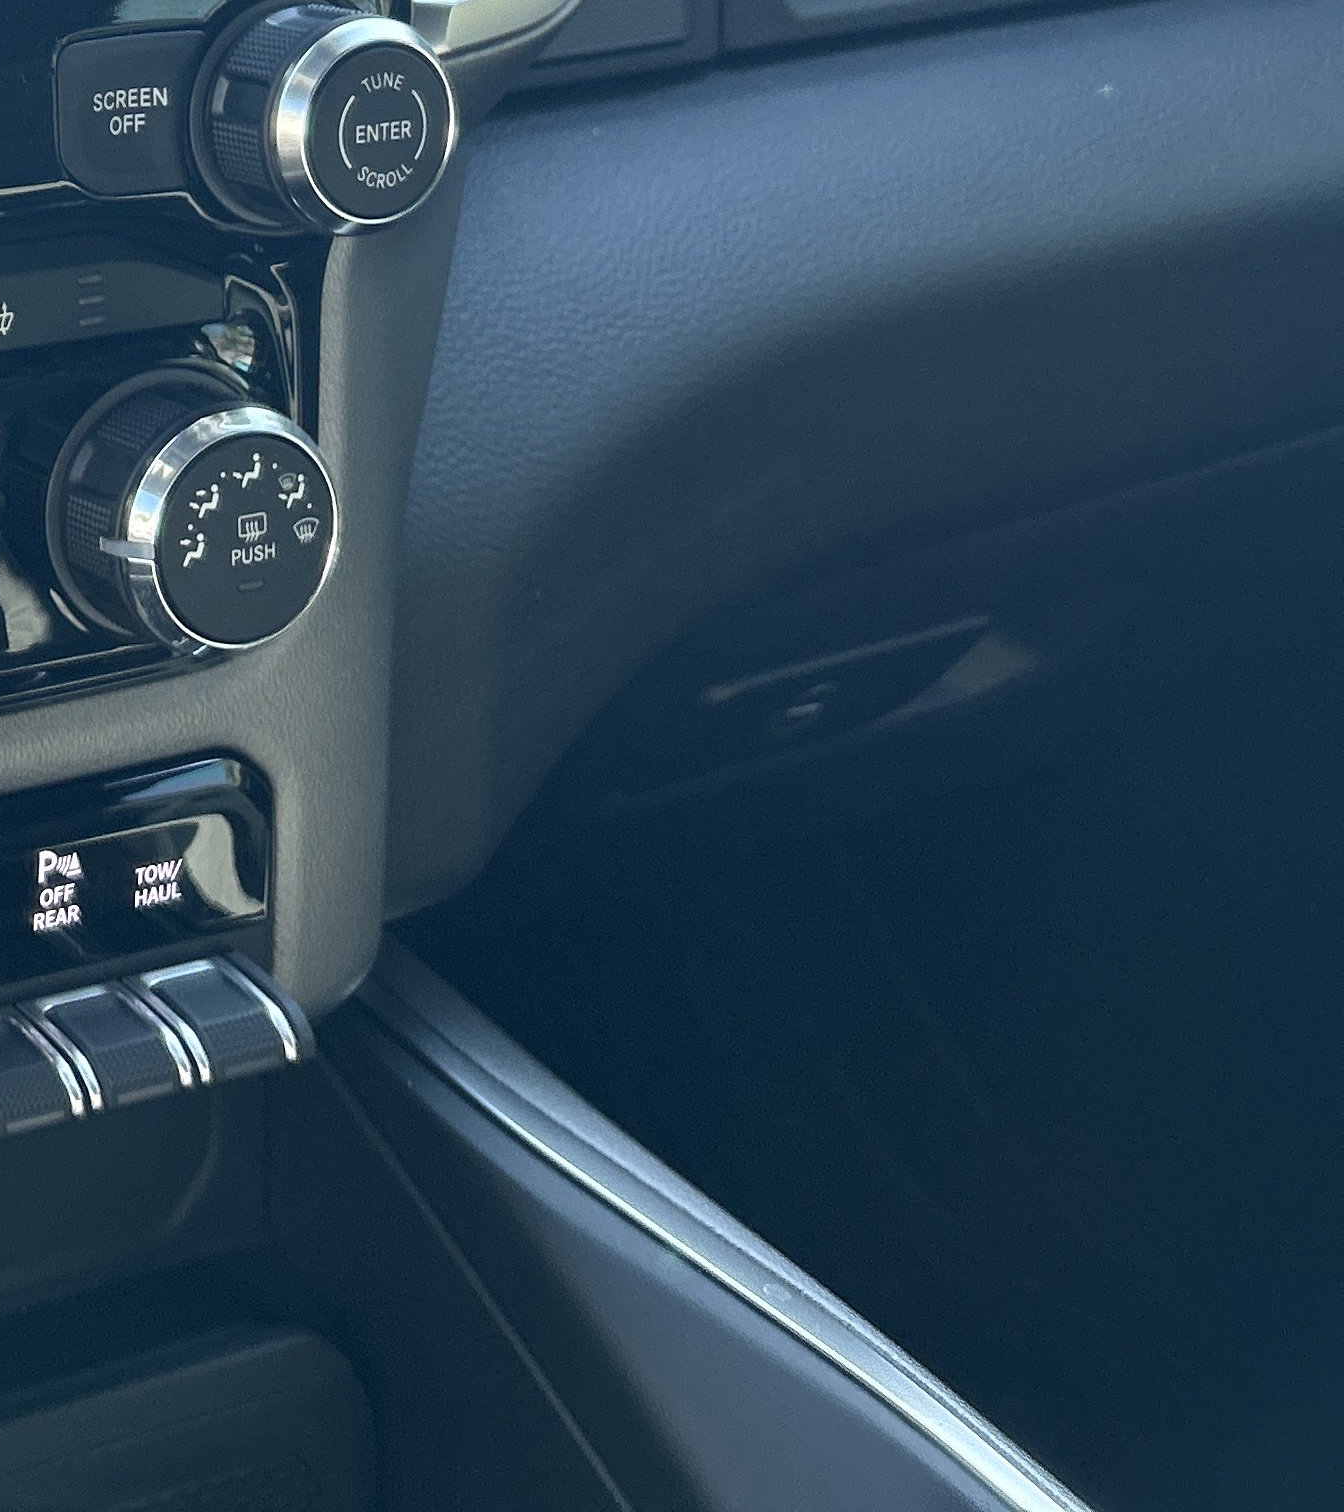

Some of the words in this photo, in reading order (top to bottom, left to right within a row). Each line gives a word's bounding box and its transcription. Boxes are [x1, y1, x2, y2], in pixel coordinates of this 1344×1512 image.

[360, 71, 406, 95] TUNE
[92, 87, 169, 113] SCREEN
[109, 114, 147, 136] OFF
[355, 119, 413, 144] ENTER
[357, 163, 415, 189] SCROLL
[231, 541, 277, 566] PUSH
[134, 857, 184, 886] TOW/
[38, 883, 77, 909] OFF
[134, 882, 183, 910] HAUL
[32, 905, 81, 933] REAR
